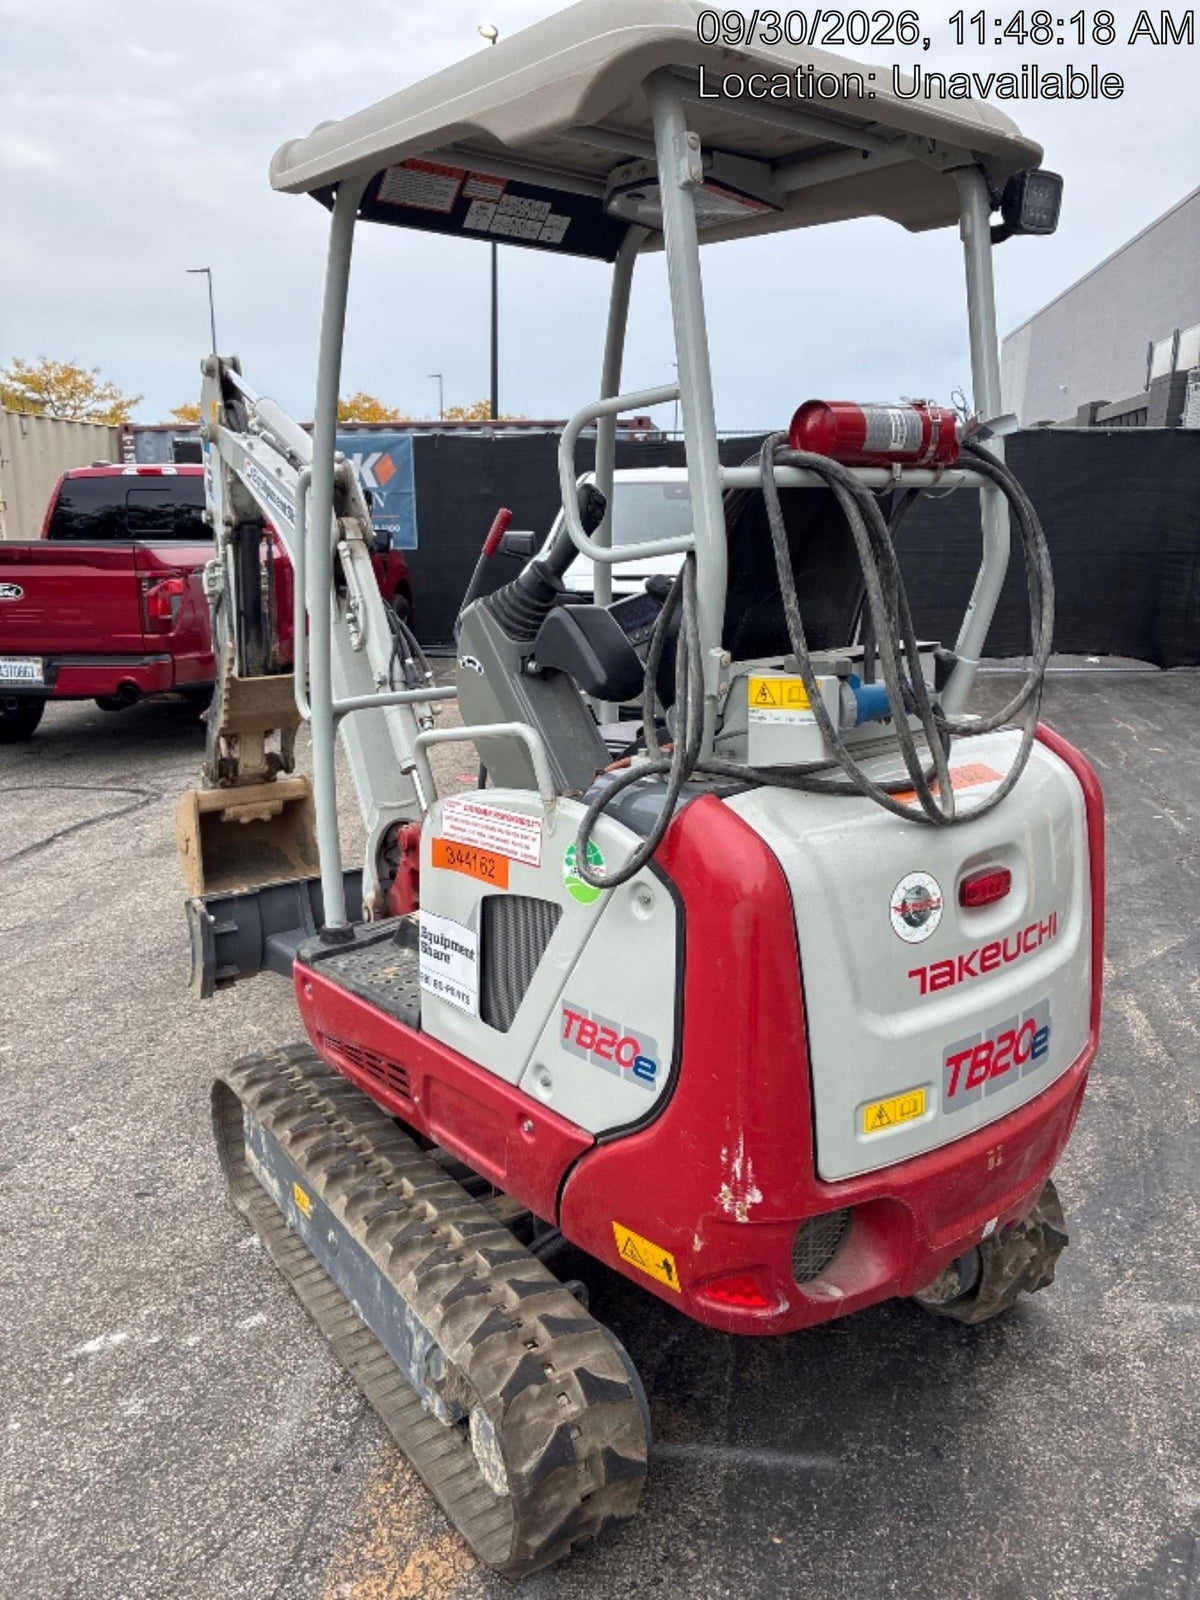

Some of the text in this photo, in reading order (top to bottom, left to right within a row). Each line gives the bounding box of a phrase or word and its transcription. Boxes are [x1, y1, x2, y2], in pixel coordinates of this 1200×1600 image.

[446, 845, 495, 879] 344162
[420, 925, 476, 963] Equipment
[421, 941, 451, 964] Share
[908, 911, 1057, 995] TAKEUCHI
[563, 1008, 657, 1083] TB20e
[945, 1017, 1050, 1098] TB20e
